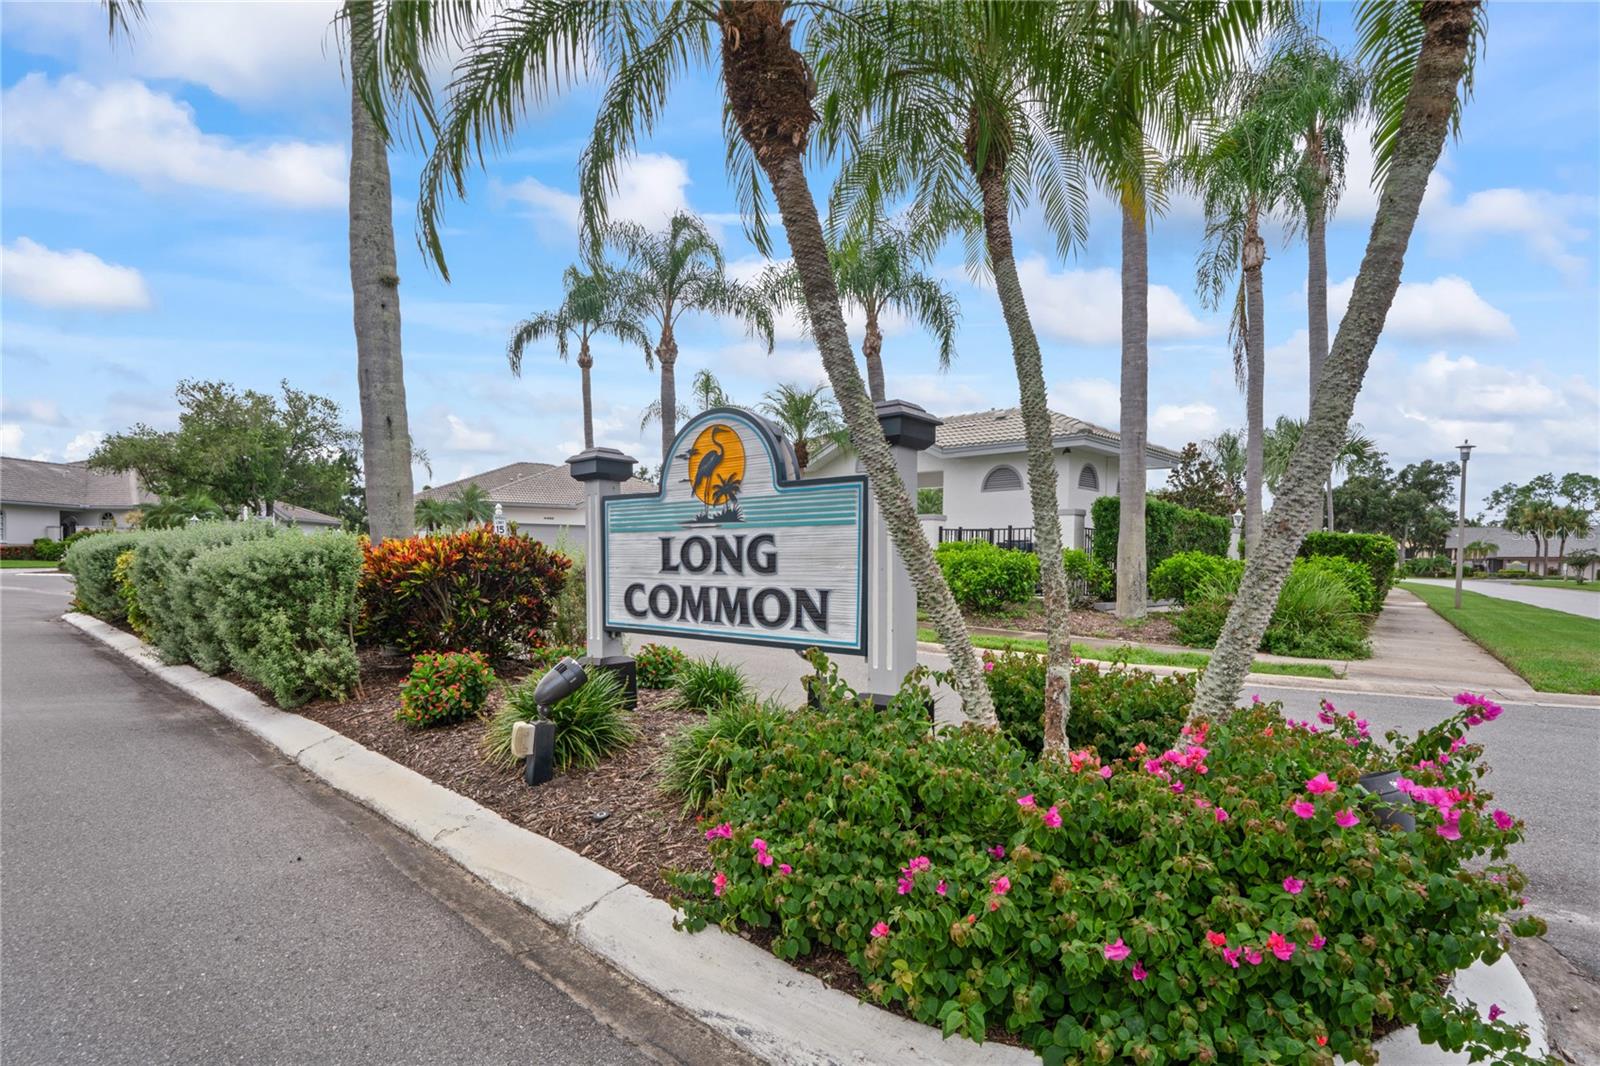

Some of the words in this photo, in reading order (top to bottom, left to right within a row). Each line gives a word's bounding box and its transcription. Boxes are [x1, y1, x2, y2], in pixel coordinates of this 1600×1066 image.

[496, 525, 505, 534] 15
[658, 533, 779, 576] LONG
[624, 582, 832, 634] COMMON
